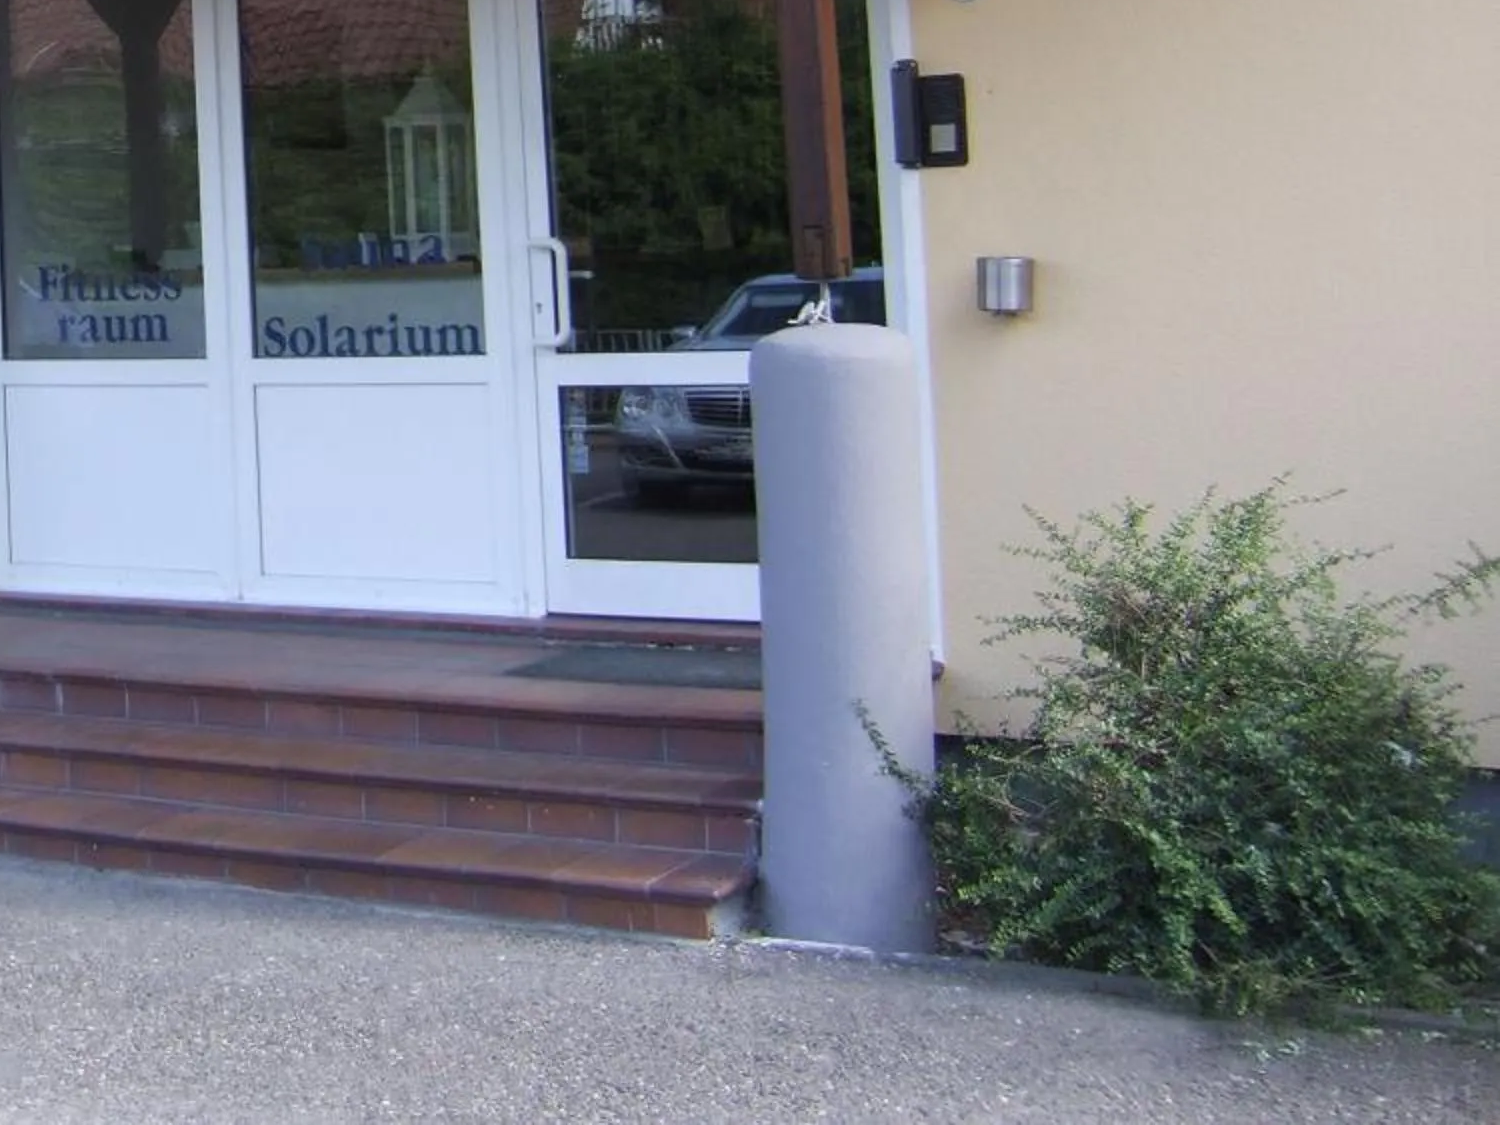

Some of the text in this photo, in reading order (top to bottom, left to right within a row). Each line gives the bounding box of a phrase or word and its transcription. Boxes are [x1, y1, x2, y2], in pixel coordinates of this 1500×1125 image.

[38, 263, 182, 302] Fitness
[57, 313, 169, 343] raum
[263, 312, 486, 356] Solarium
